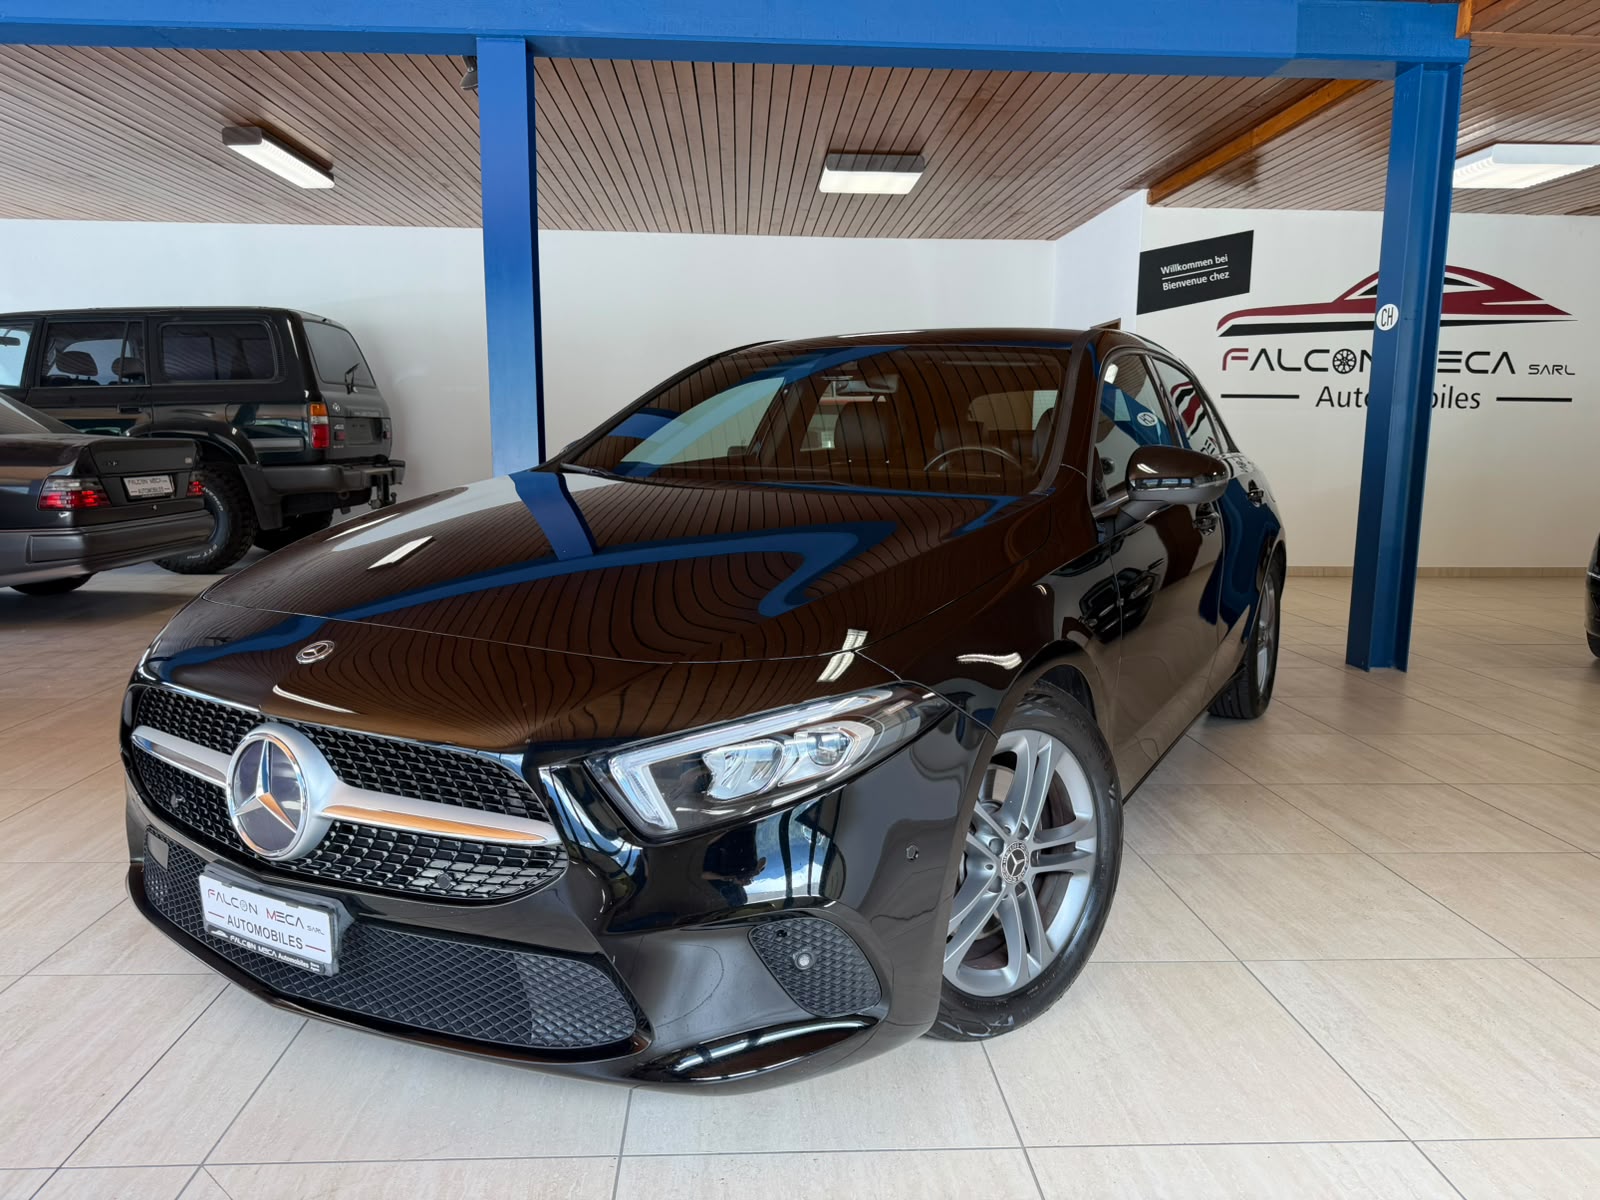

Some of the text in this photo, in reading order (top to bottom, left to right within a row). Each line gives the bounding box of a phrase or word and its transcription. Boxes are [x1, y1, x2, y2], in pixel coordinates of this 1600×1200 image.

[1160, 253, 1229, 275] Willkommen bei
[1162, 271, 1230, 291] Bienvenue chez
[1381, 306, 1394, 328] CH
[1528, 364, 1576, 376] SARL
[207, 888, 258, 915] FALCON
[266, 907, 304, 929] MECA
[227, 914, 303, 950] AUTOMOBILES
